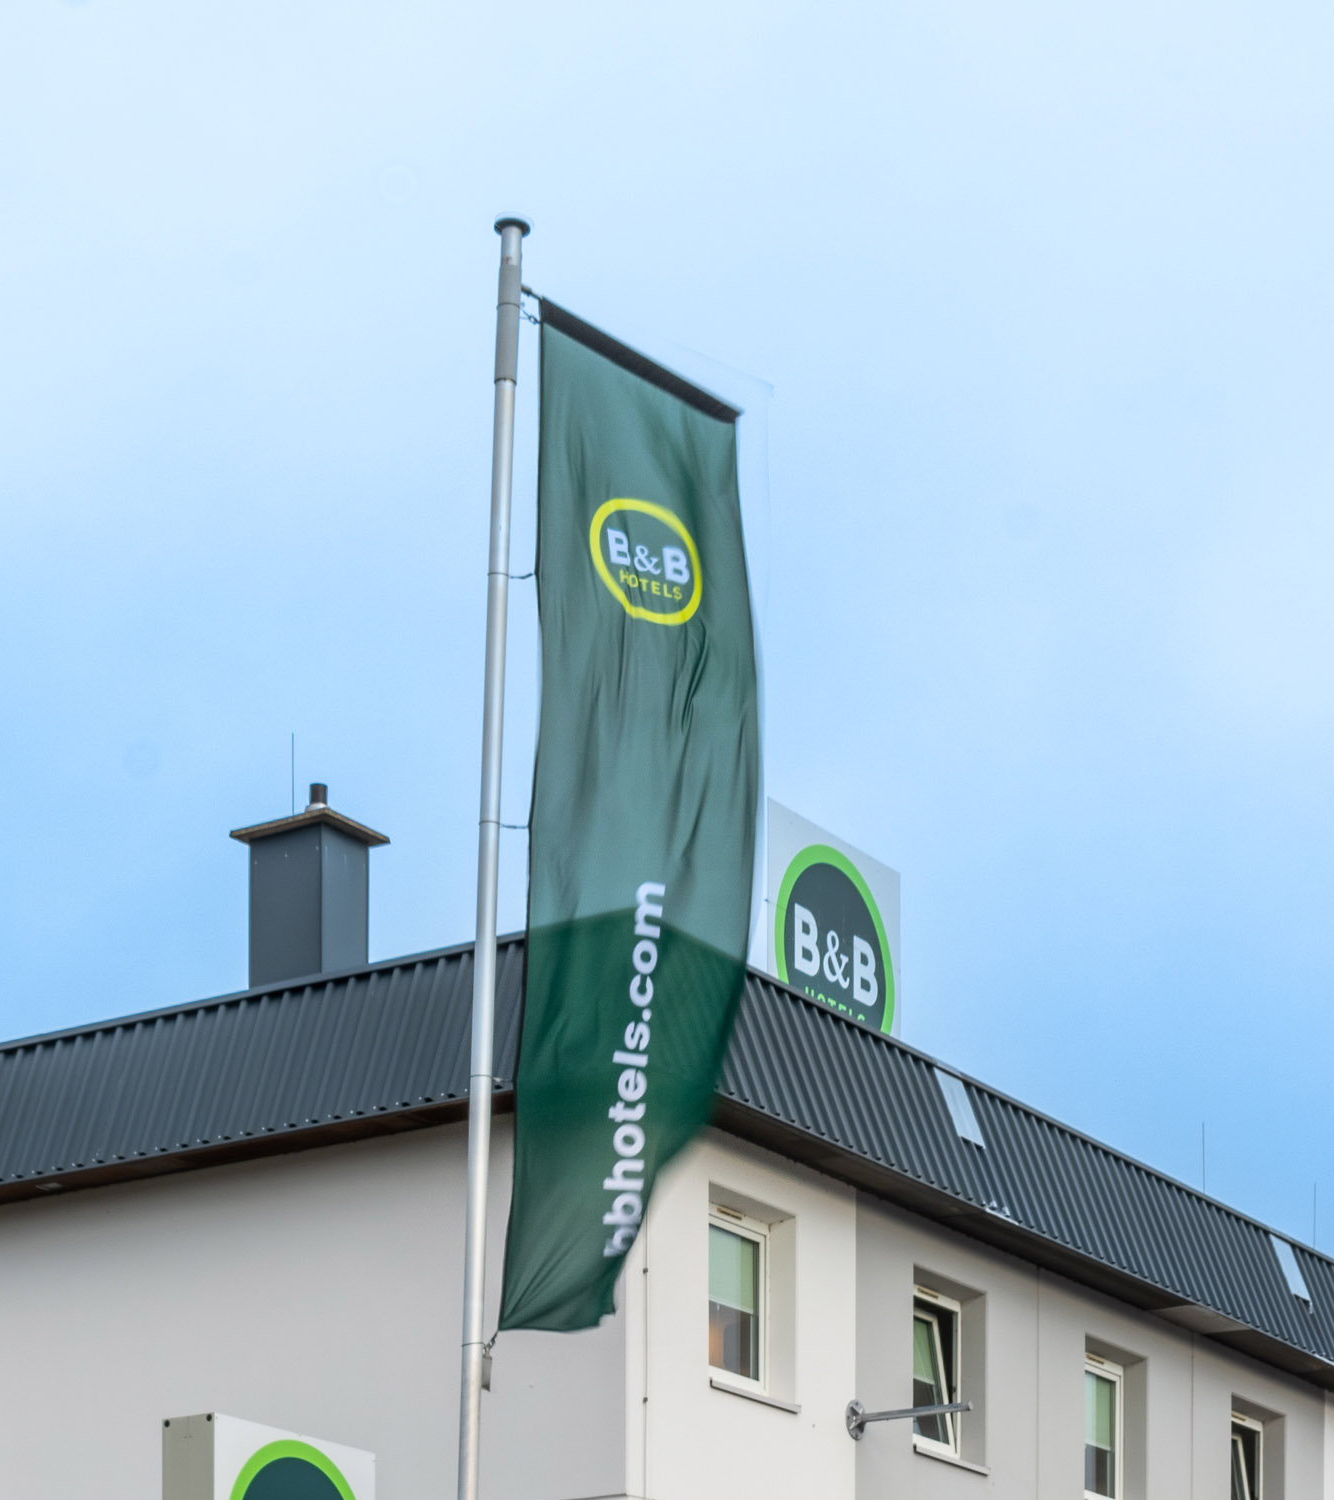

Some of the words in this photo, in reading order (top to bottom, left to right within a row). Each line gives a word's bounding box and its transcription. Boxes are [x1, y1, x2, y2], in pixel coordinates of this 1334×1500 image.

[607, 527, 691, 585] B&B
[619, 568, 683, 601] HOTELS
[794, 902, 879, 1007] B&B
[603, 881, 666, 1258] bbhotels.com
